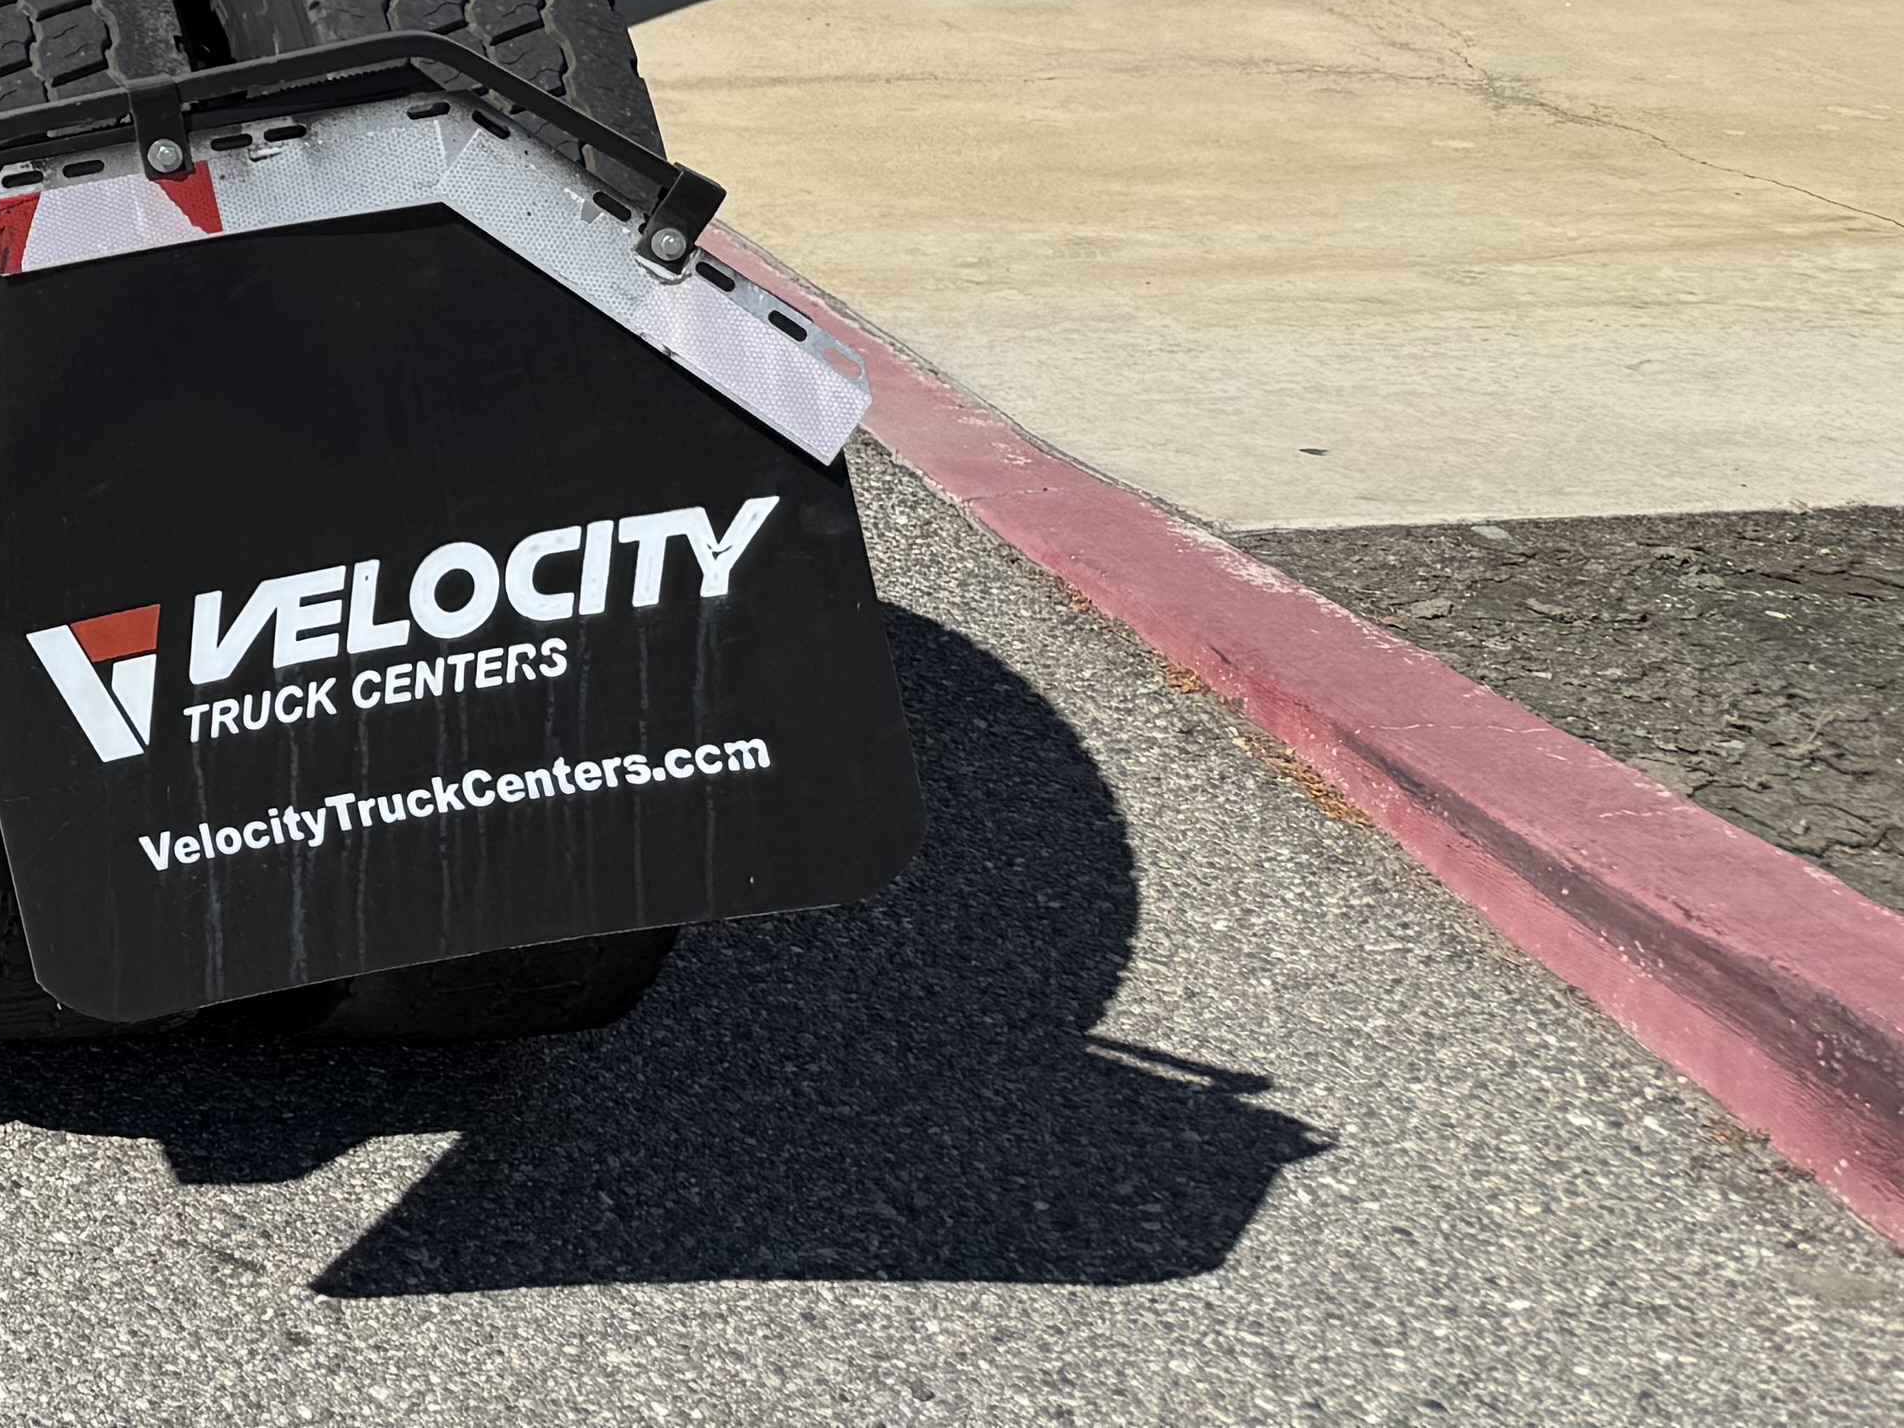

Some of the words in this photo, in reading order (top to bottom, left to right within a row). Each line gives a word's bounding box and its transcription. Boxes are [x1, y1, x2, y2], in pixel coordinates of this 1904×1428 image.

[188, 495, 781, 686] VELOCITY
[182, 677, 338, 743] TRUCK
[351, 637, 568, 709] CENTERS
